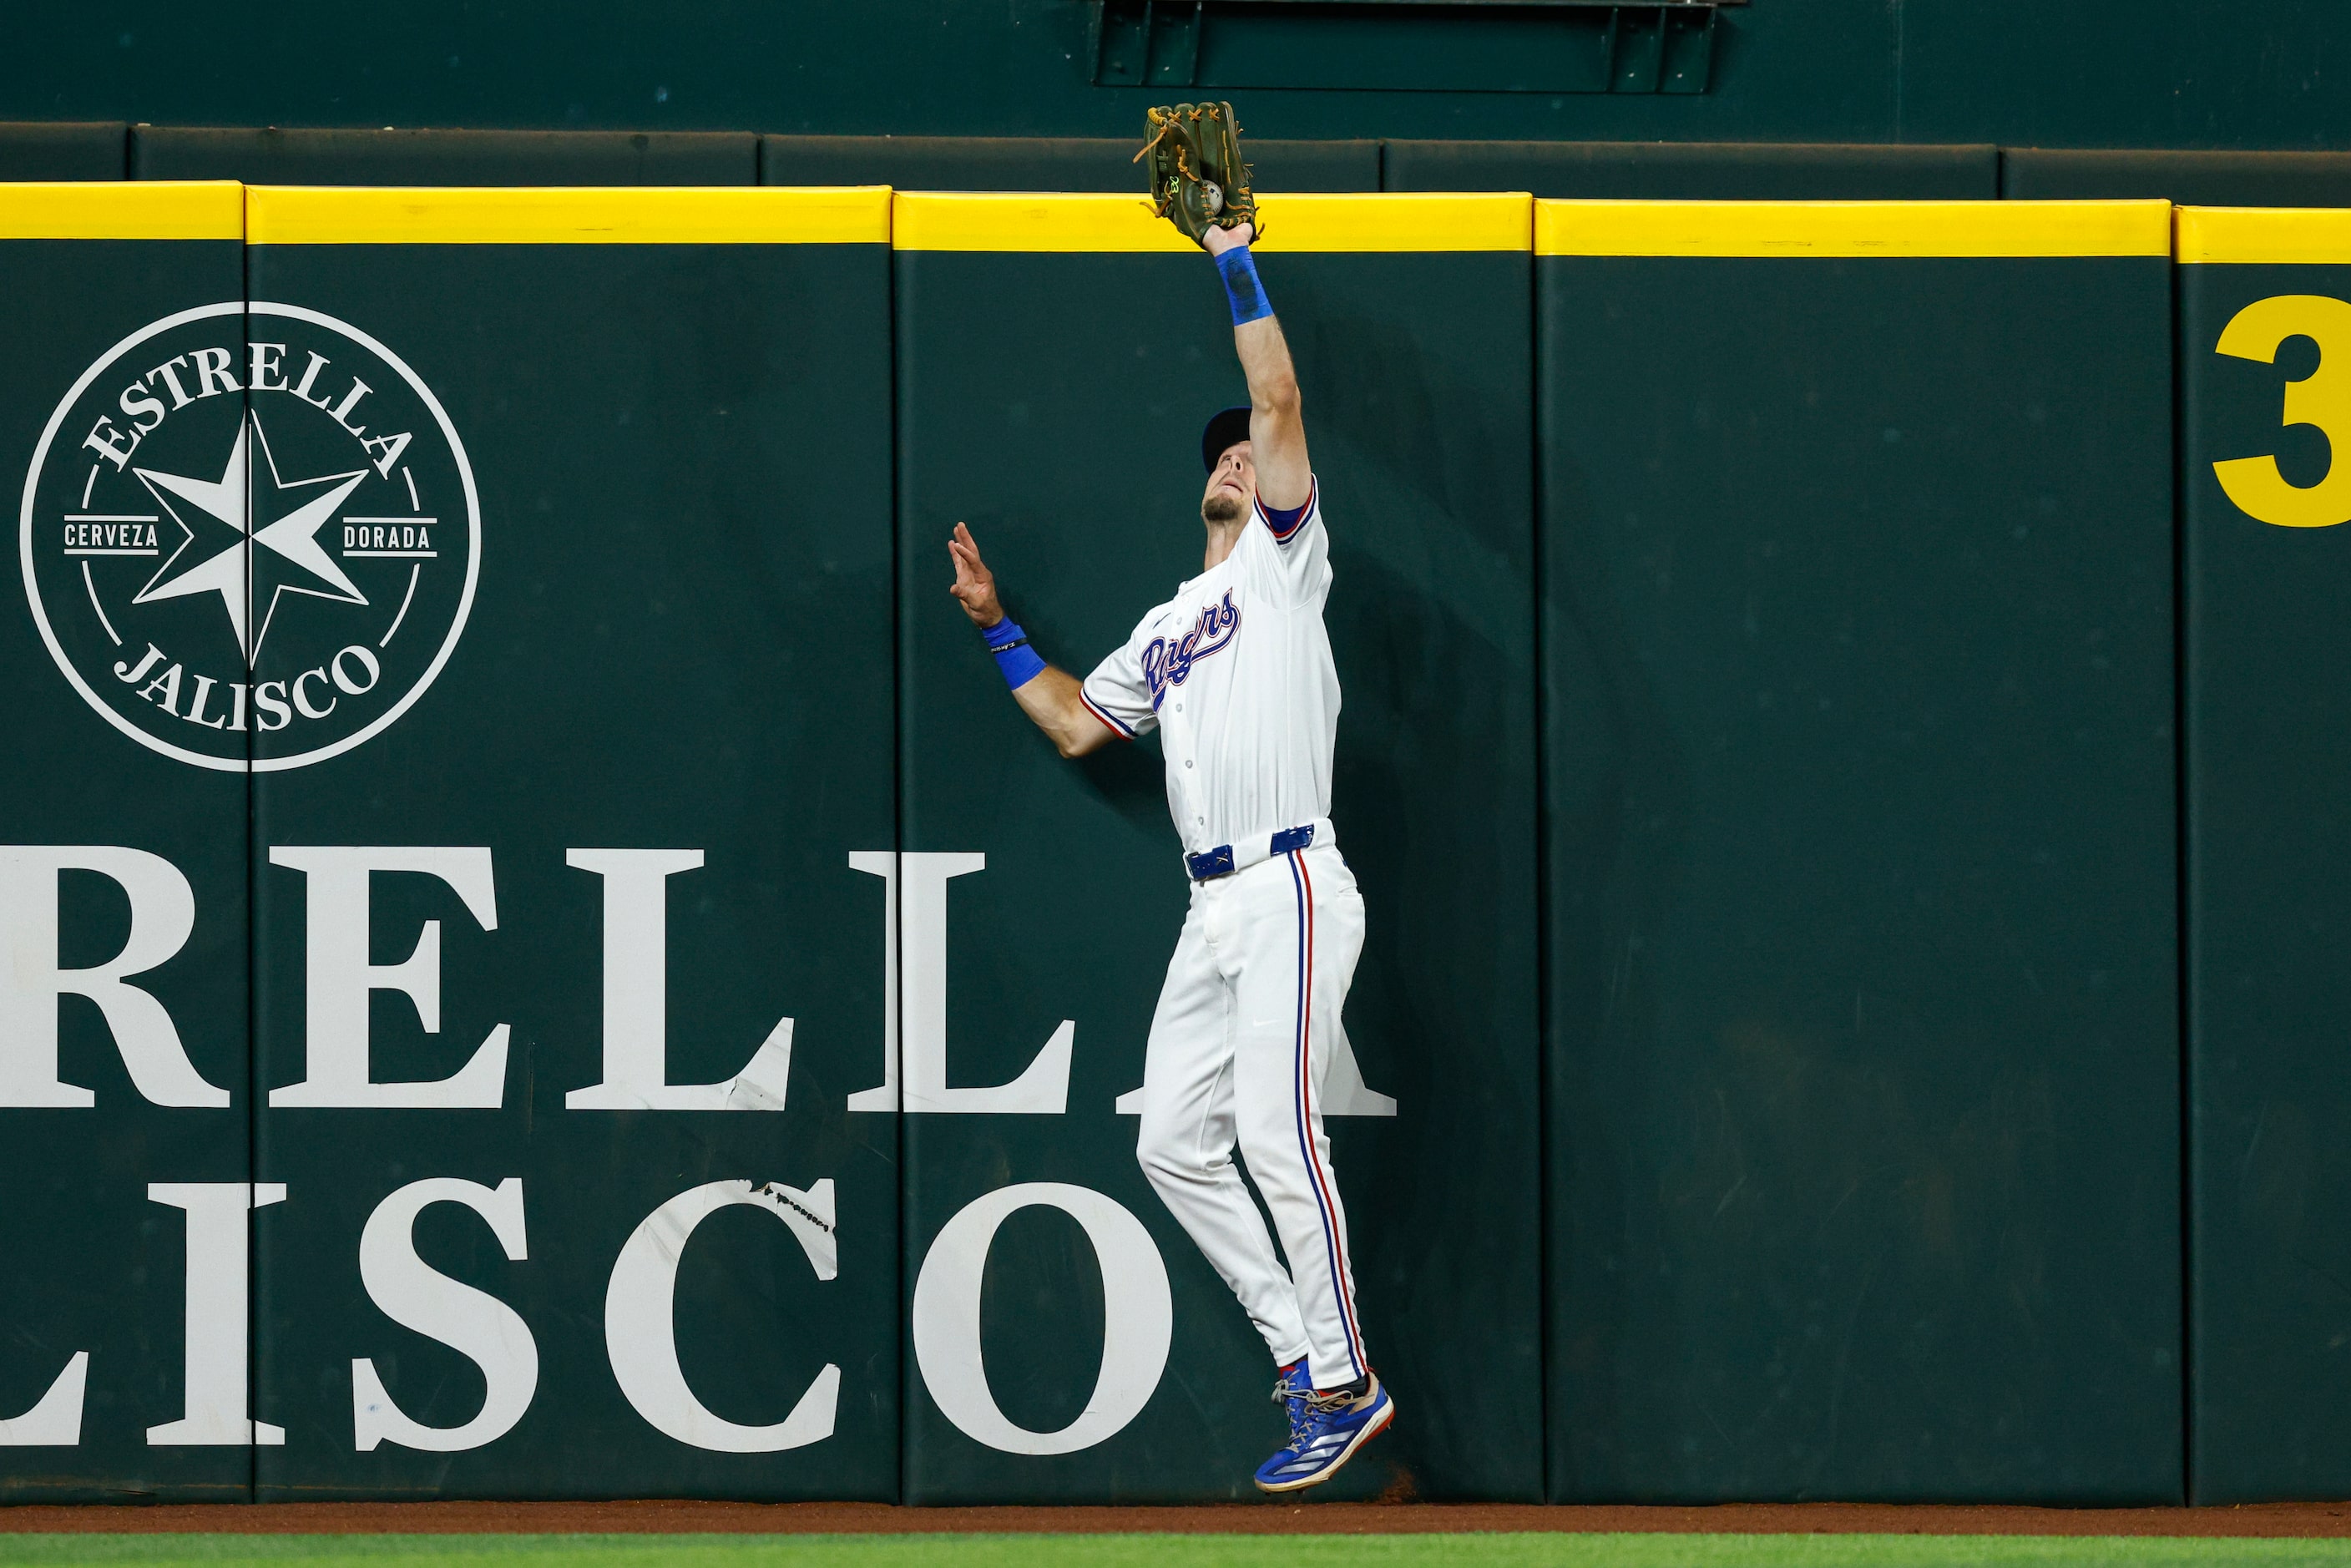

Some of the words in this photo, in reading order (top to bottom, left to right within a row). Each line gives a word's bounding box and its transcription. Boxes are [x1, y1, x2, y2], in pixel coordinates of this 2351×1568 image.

[81, 343, 413, 481] ESTRELLA
[2212, 294, 2351, 528] 3
[63, 524, 159, 547] CERVEZA
[343, 526, 431, 549] DORADA
[114, 641, 380, 732] JALISCO
[1141, 586, 1241, 713] Rngrs
[0, 845, 1398, 1116] RELL
